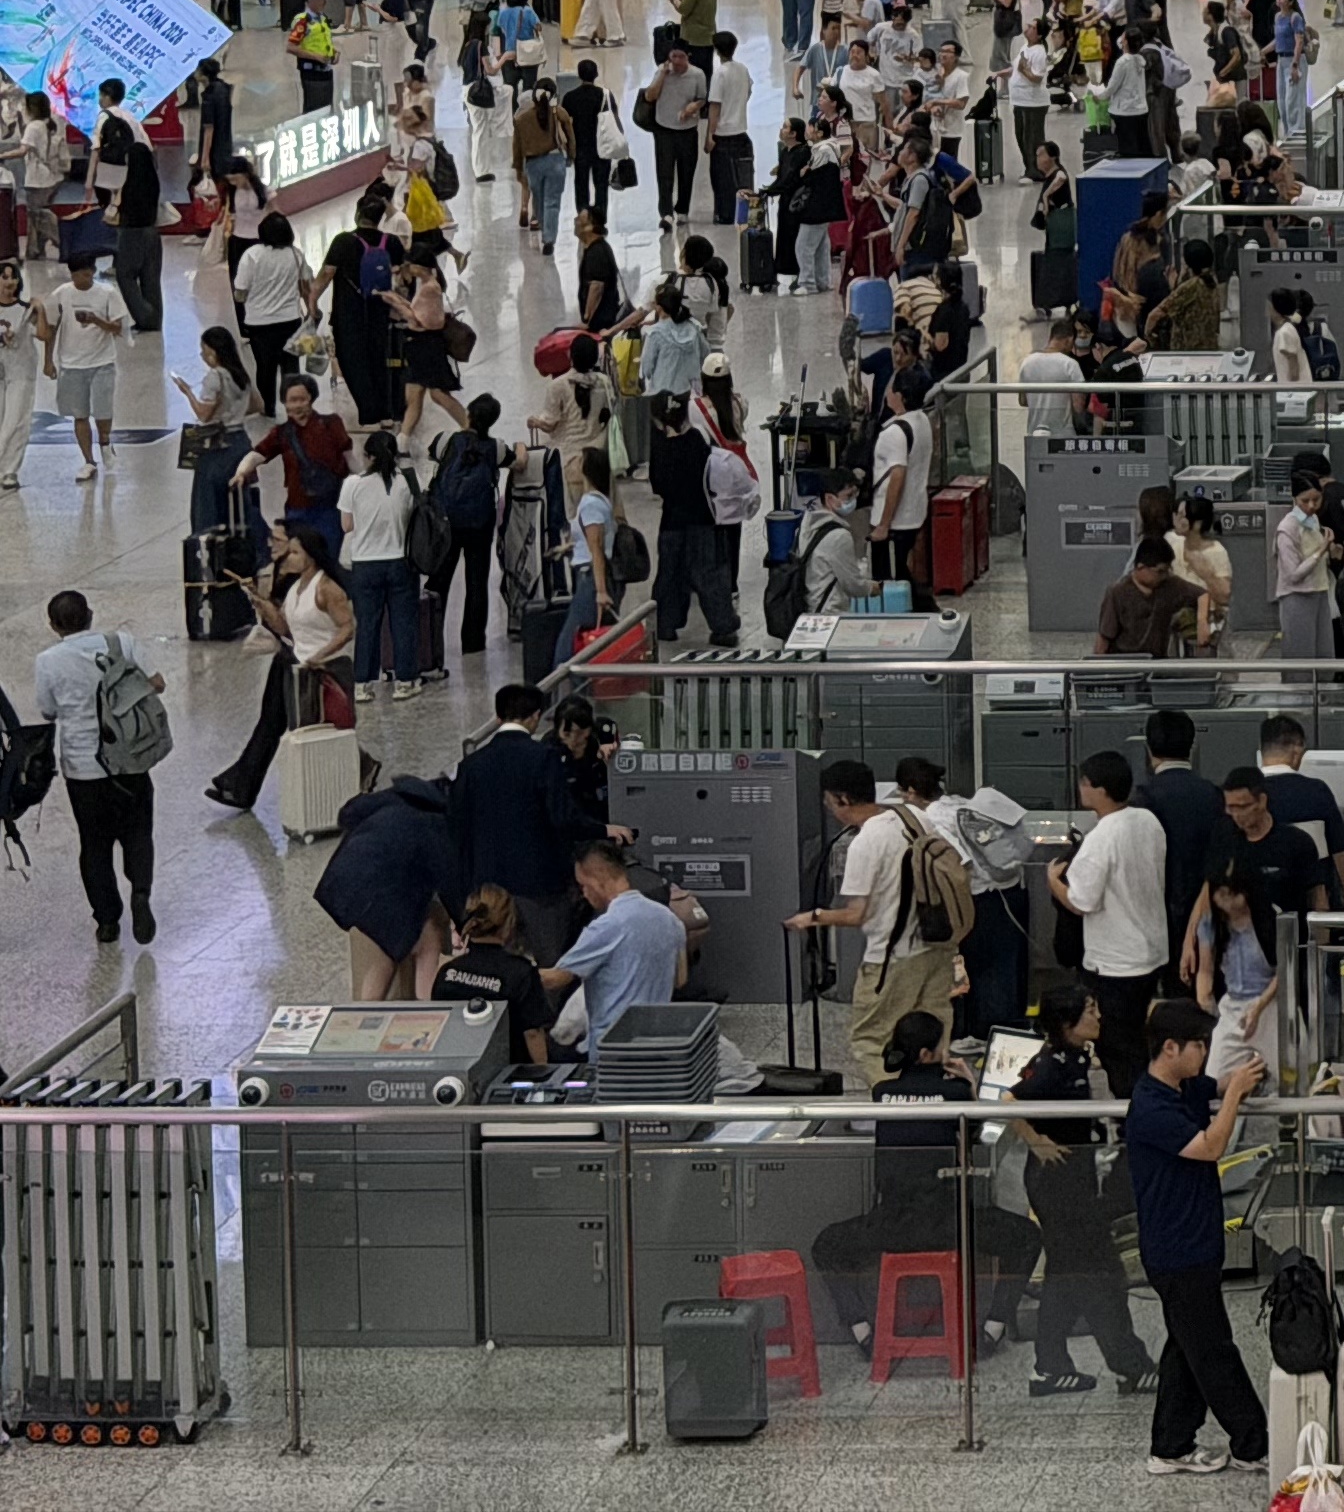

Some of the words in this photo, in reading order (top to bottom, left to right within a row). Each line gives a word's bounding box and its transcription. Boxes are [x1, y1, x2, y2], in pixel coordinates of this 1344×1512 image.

[138, 4, 169, 33] CHINA
[160, 22, 189, 45] 2026
[239, 100, 380, 186] 了就是深圳人
